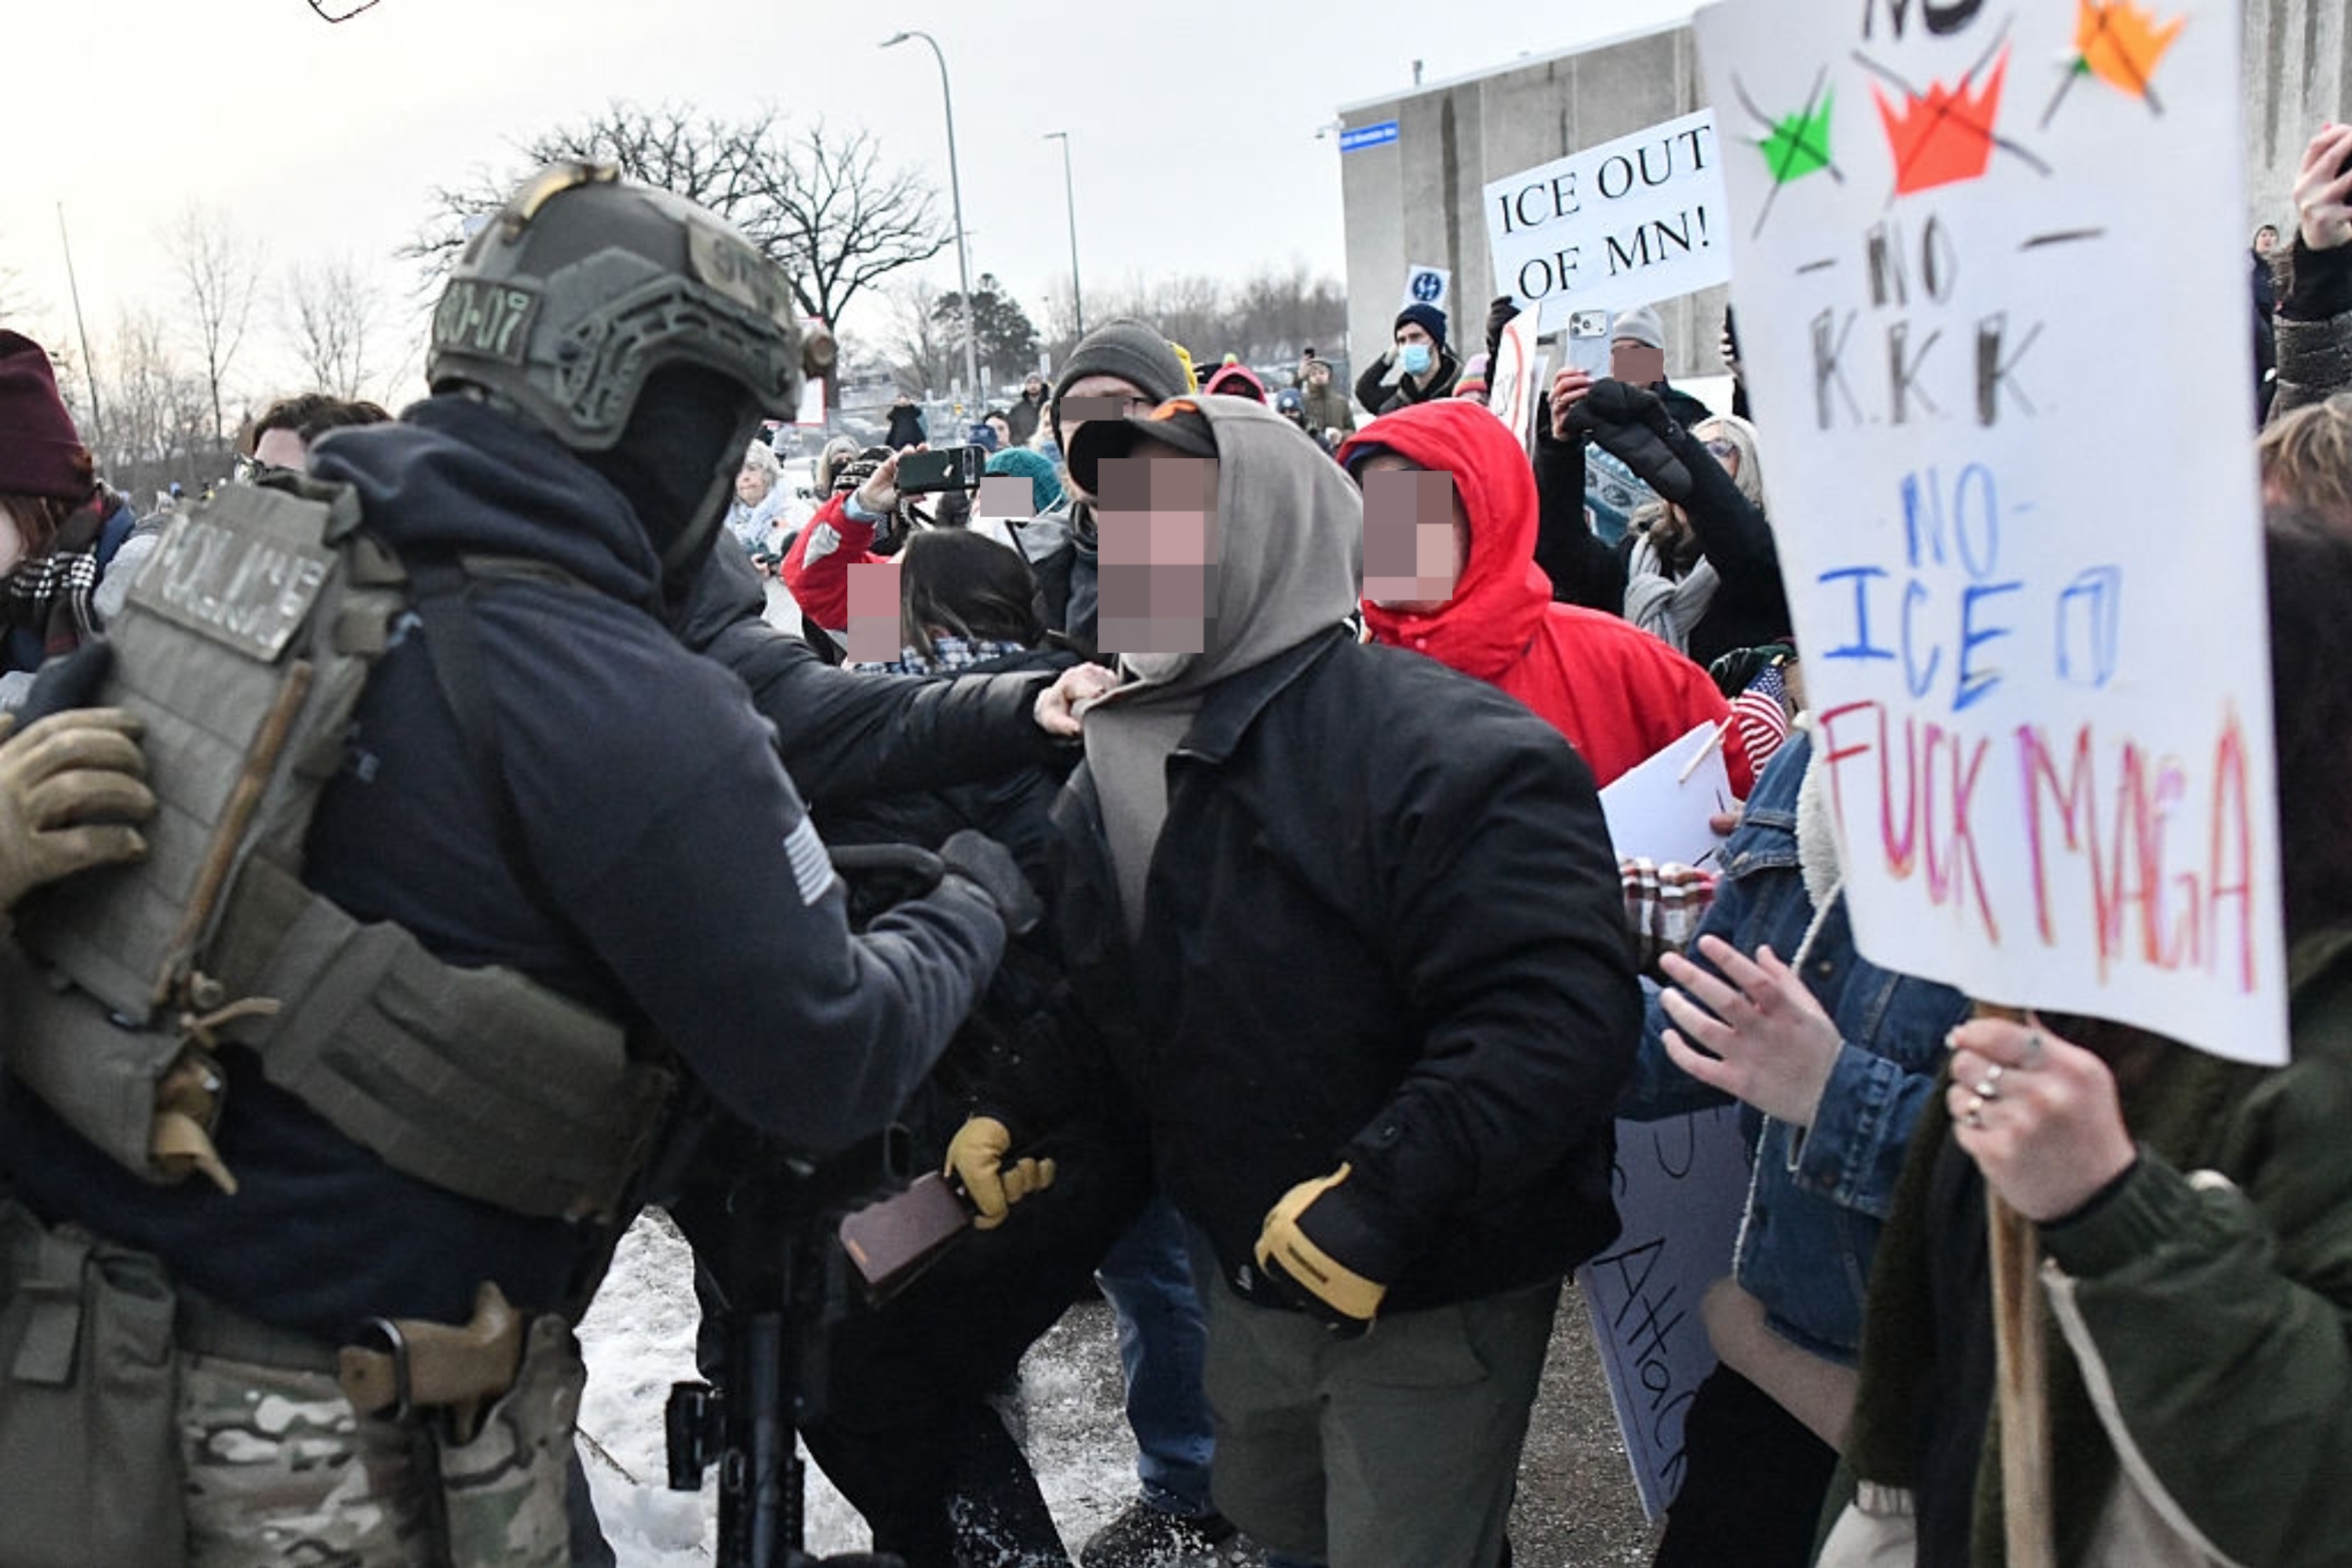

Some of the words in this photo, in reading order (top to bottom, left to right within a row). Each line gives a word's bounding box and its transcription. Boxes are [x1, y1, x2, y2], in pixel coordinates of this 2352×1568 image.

[1498, 172, 1581, 235] ICE
[1597, 126, 1711, 200] OUT
[1517, 246, 1580, 302] OF
[1604, 206, 1709, 278] MN!
[1818, 566, 2024, 712] ICE
[1819, 700, 2001, 948] FUCK
[2015, 695, 2258, 995] MAGA
